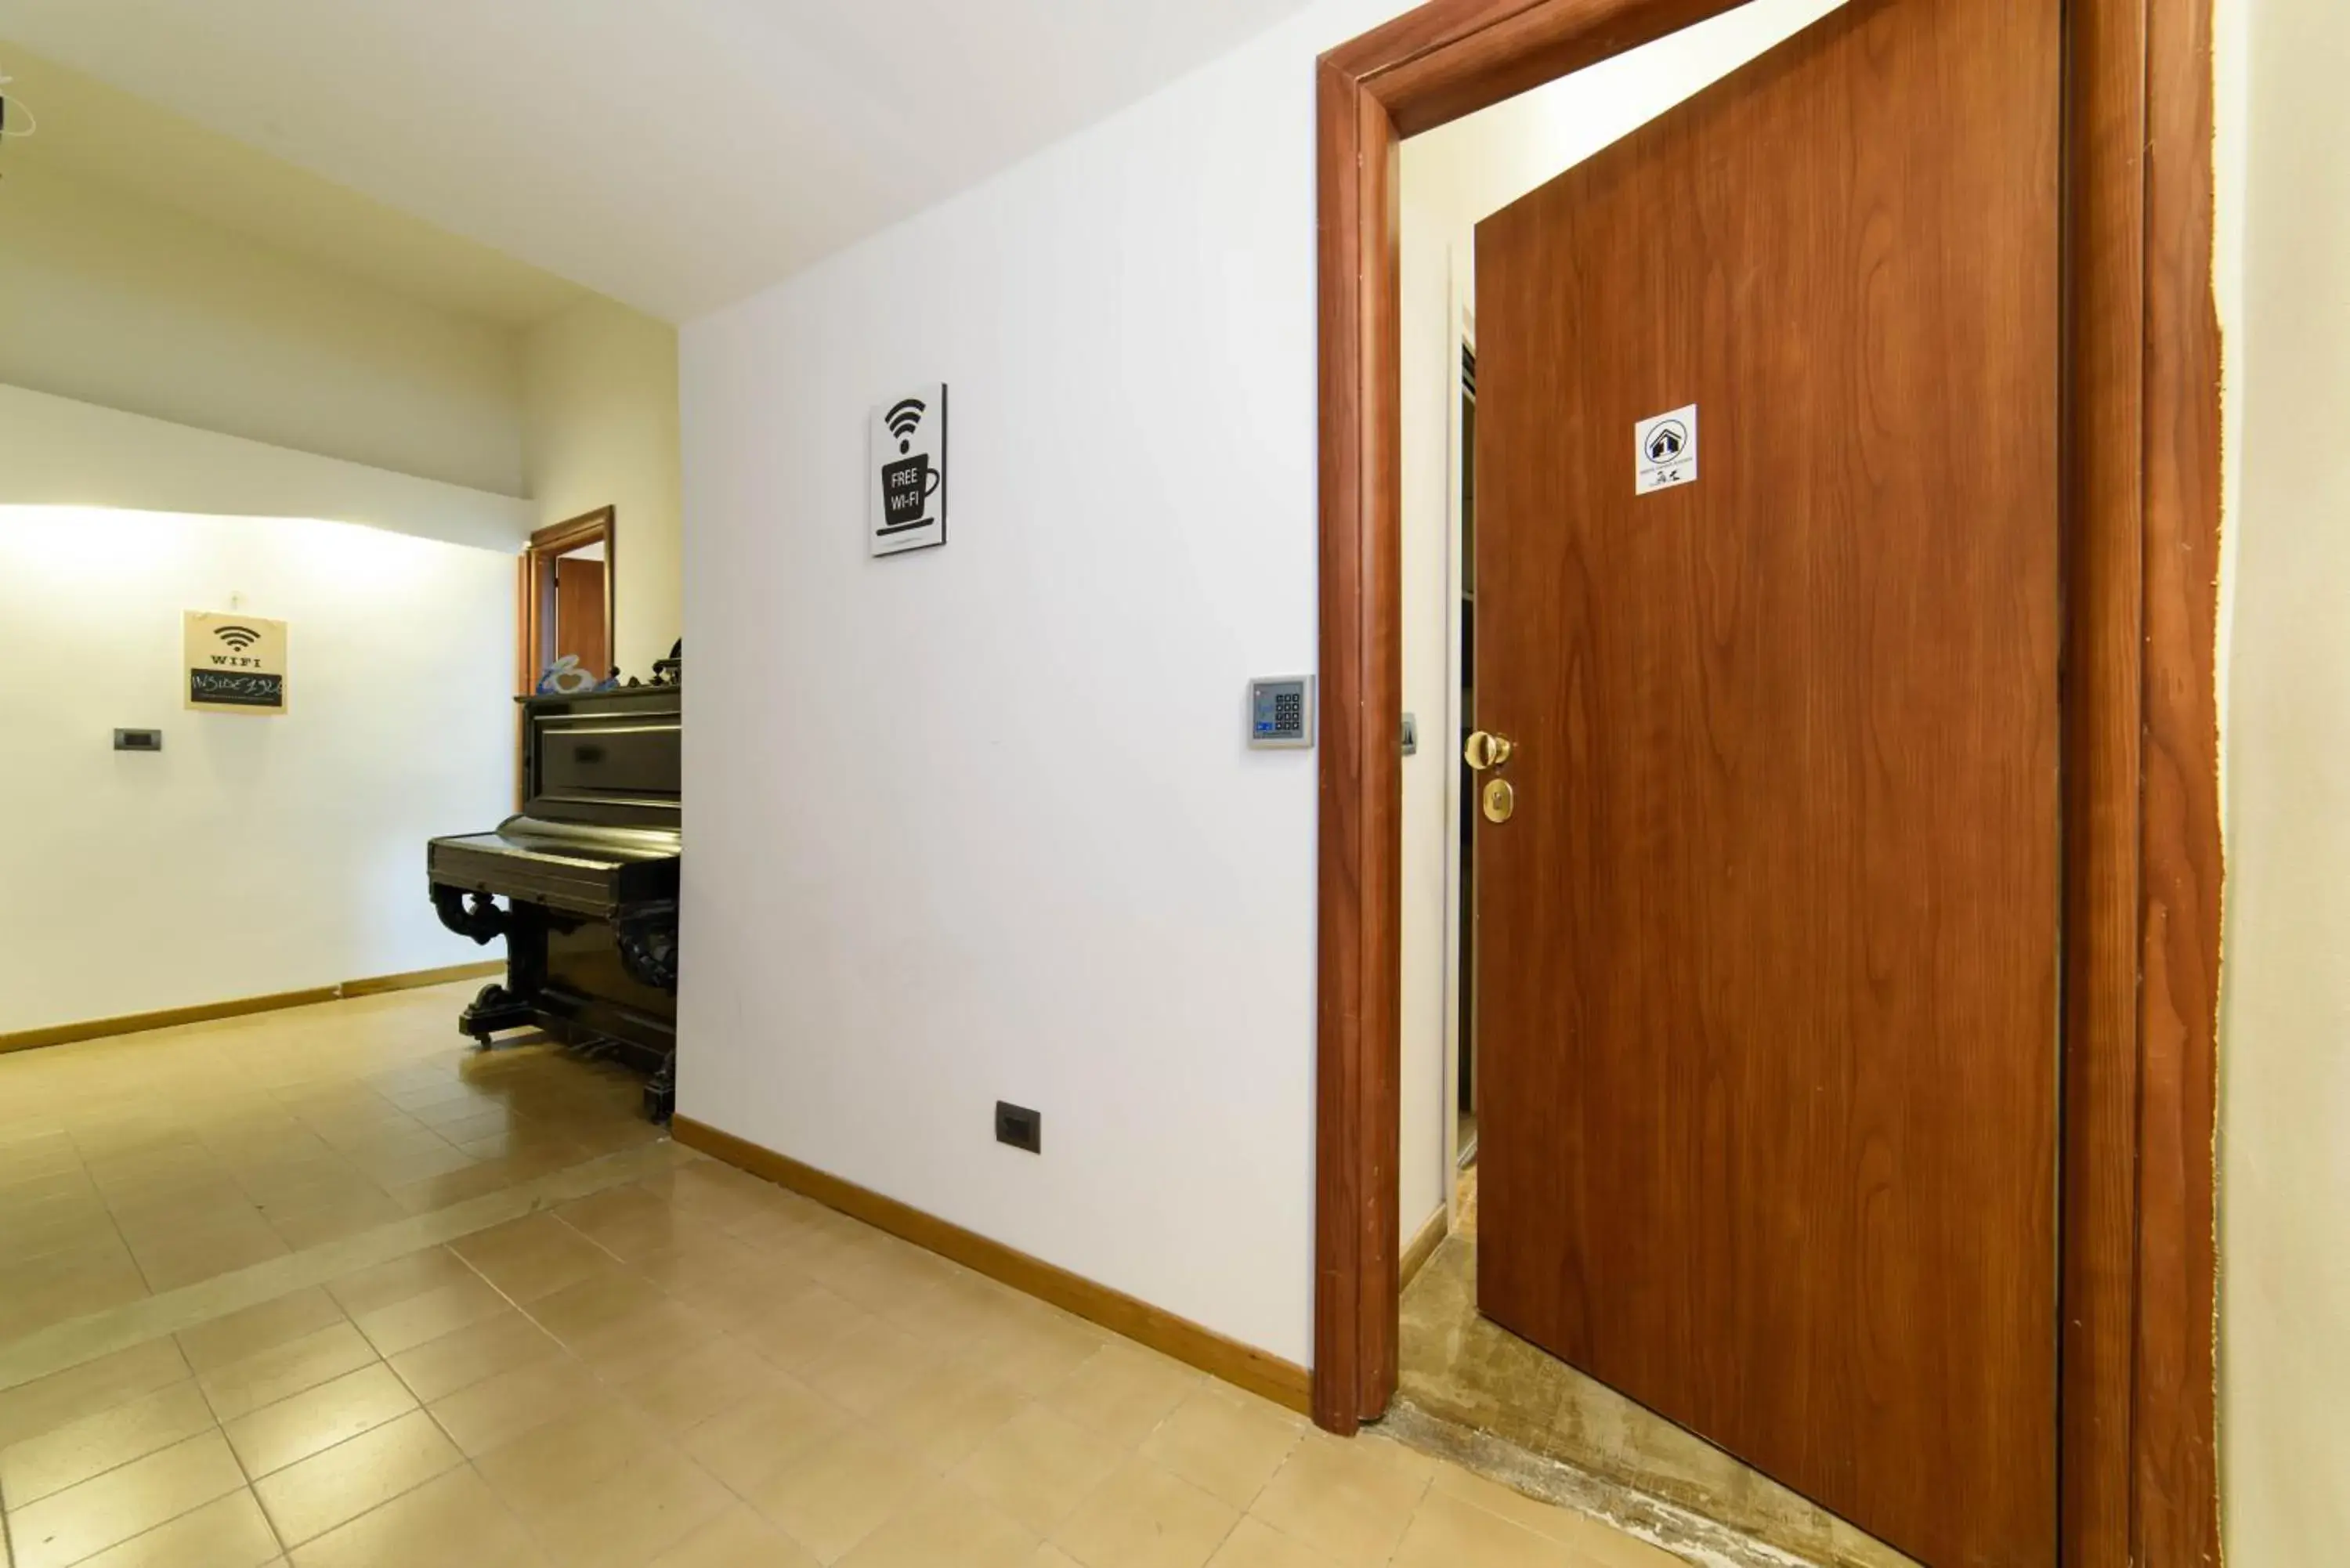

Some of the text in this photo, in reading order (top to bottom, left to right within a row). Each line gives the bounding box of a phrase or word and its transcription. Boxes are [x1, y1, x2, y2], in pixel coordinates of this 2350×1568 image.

[891, 468, 918, 488] FREE
[891, 490, 919, 511] WI-FI
[212, 655, 261, 668] WIFI
